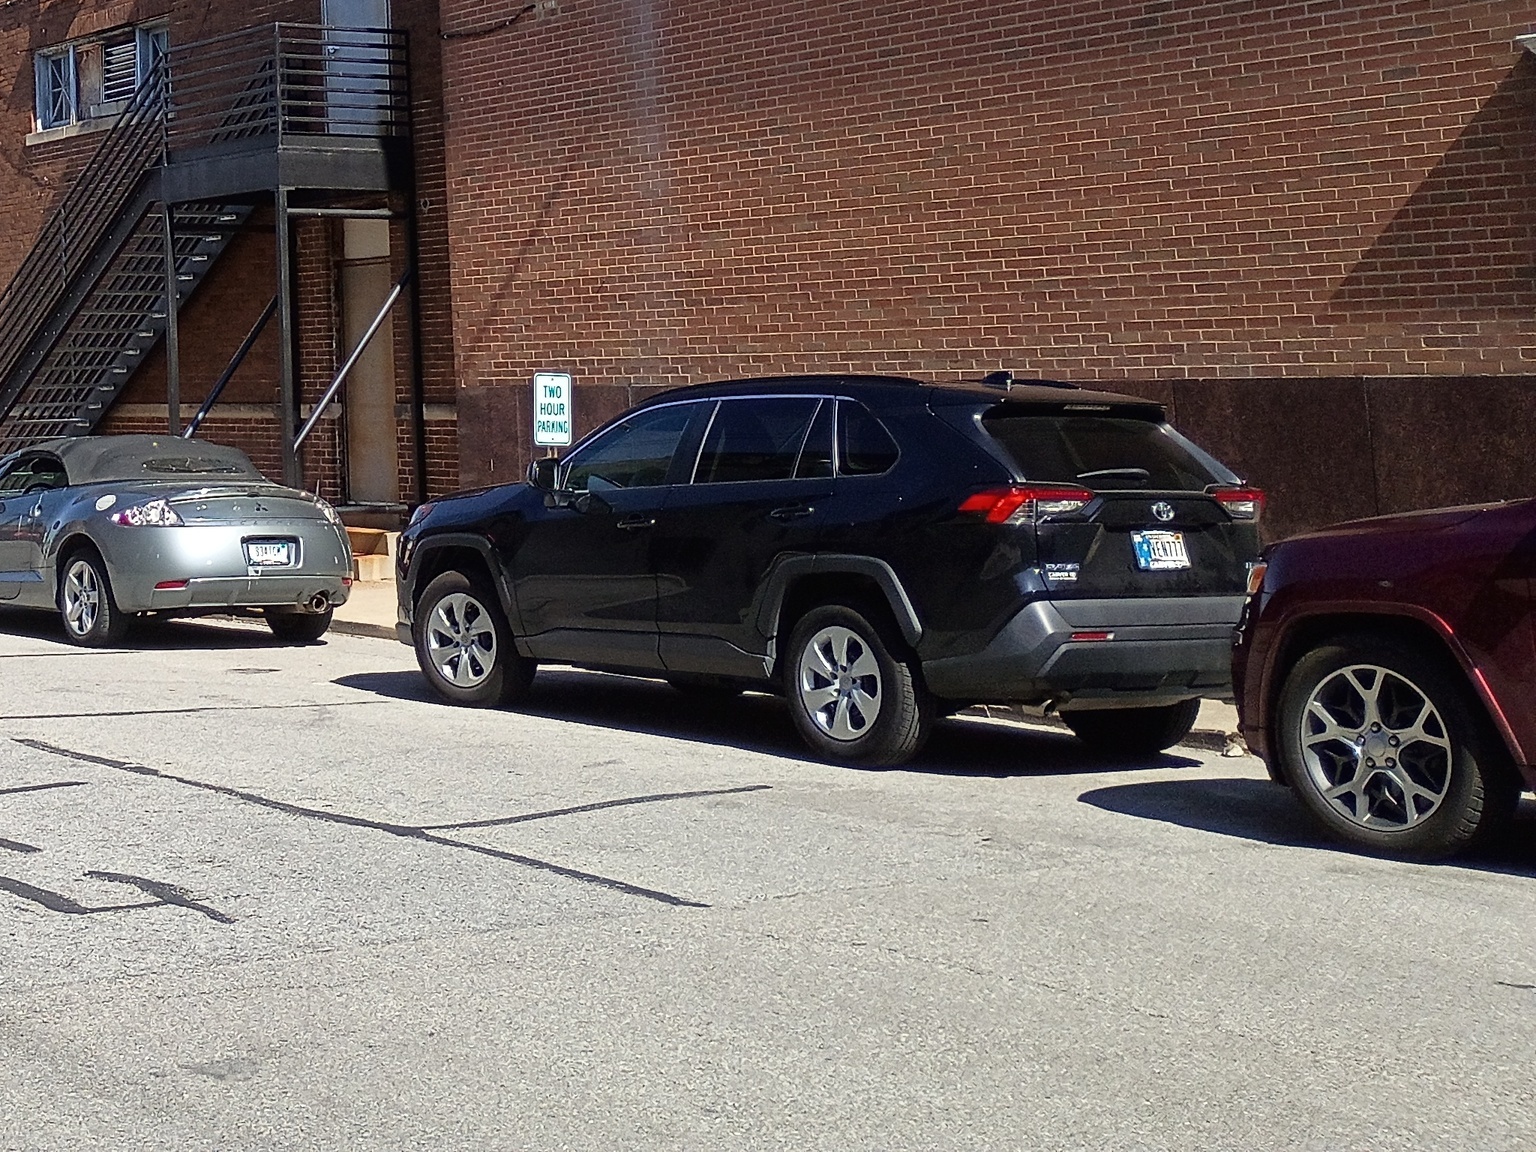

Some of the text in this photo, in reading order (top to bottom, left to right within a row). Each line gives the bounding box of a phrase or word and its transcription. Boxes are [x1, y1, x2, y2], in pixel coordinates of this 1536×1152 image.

[542, 385, 562, 399] TWO
[539, 403, 566, 416] HOUR
[537, 420, 569, 434] PARKING
